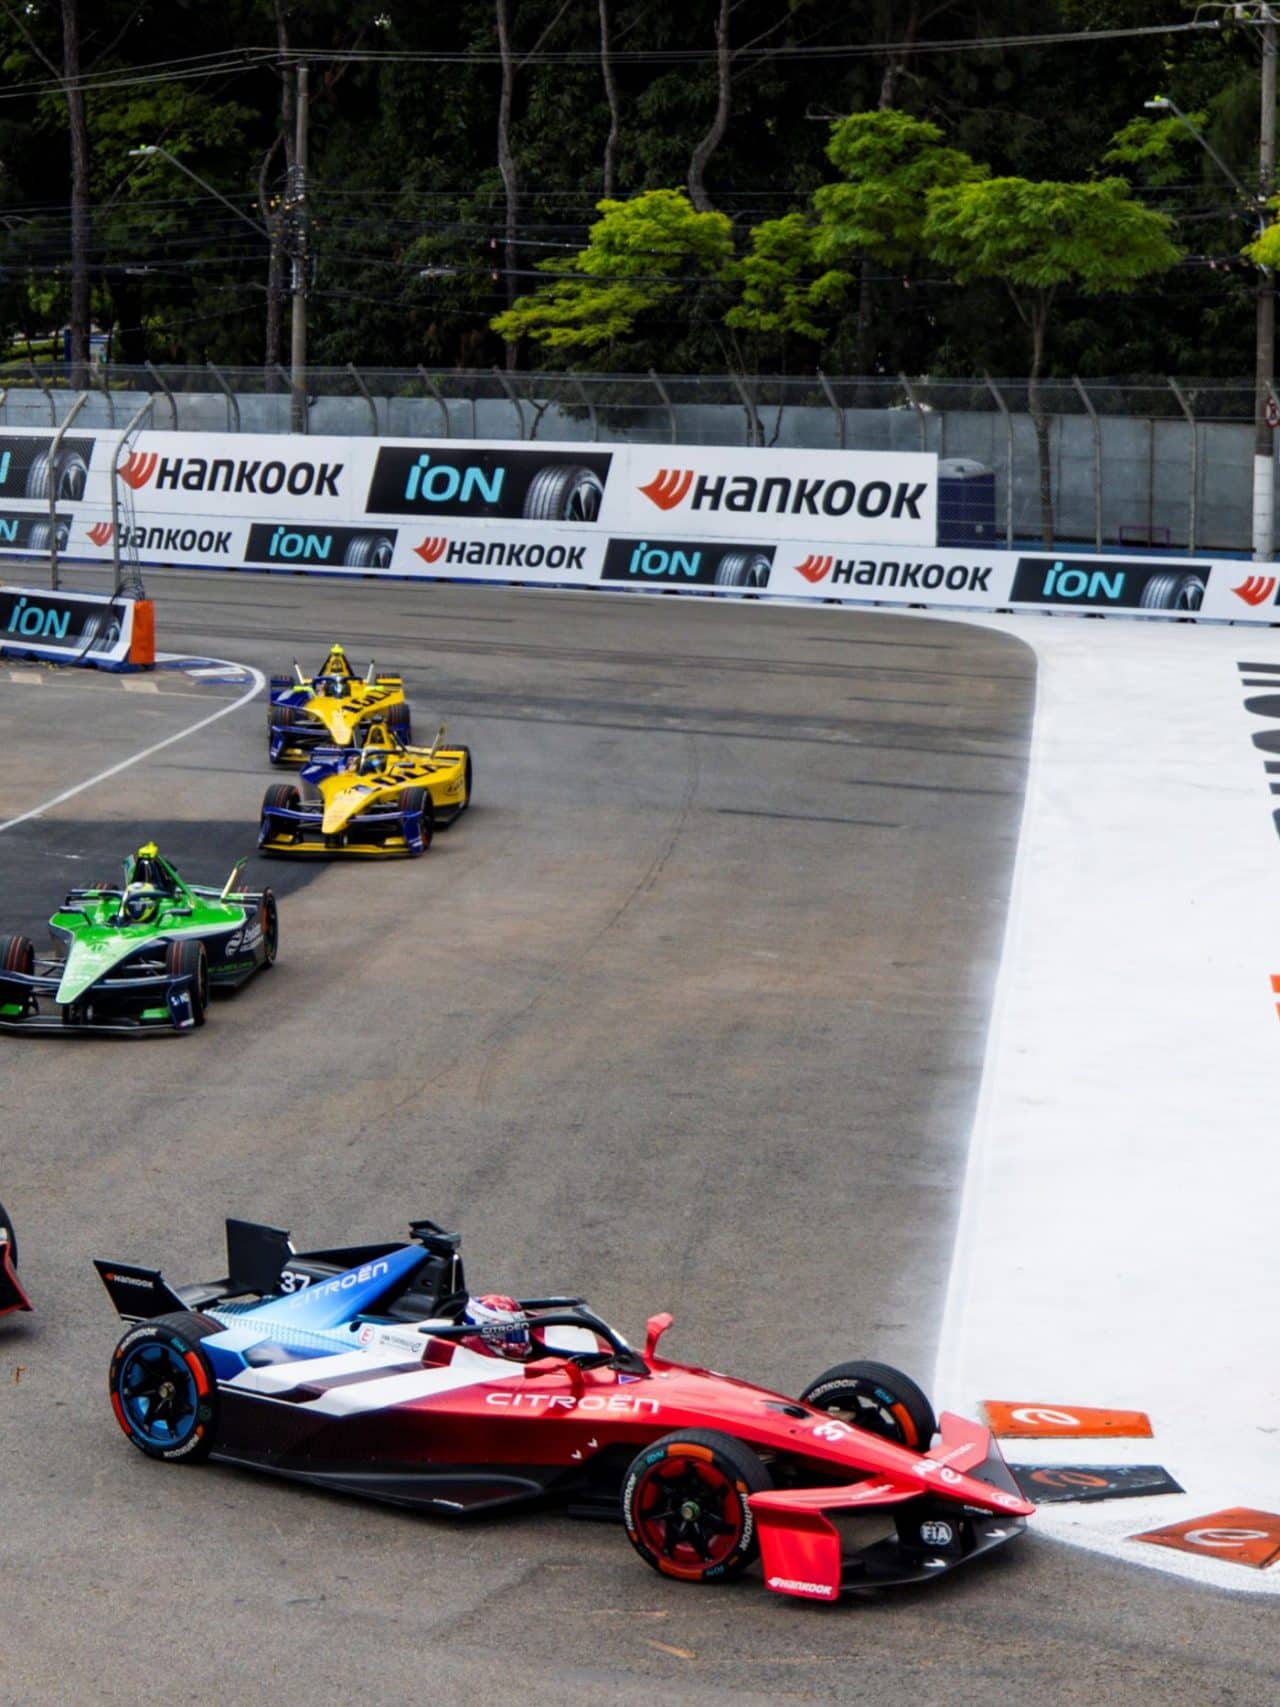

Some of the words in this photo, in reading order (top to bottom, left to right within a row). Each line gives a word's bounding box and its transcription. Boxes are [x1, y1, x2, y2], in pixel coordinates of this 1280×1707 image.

[155, 456, 344, 496] HanKOOK
[405, 455, 505, 504] iON
[691, 475, 928, 519] HanKOOK
[269, 526, 333, 559] iON
[446, 539, 587, 569] HanKOOK
[628, 541, 702, 577] iON
[831, 558, 993, 593] HanKOOK
[1042, 560, 1126, 600] iON
[7, 597, 70, 639] iON
[280, 1271, 311, 1293] 37
[486, 1392, 660, 1414] CITROËN
[922, 1526, 949, 1540] FIA
